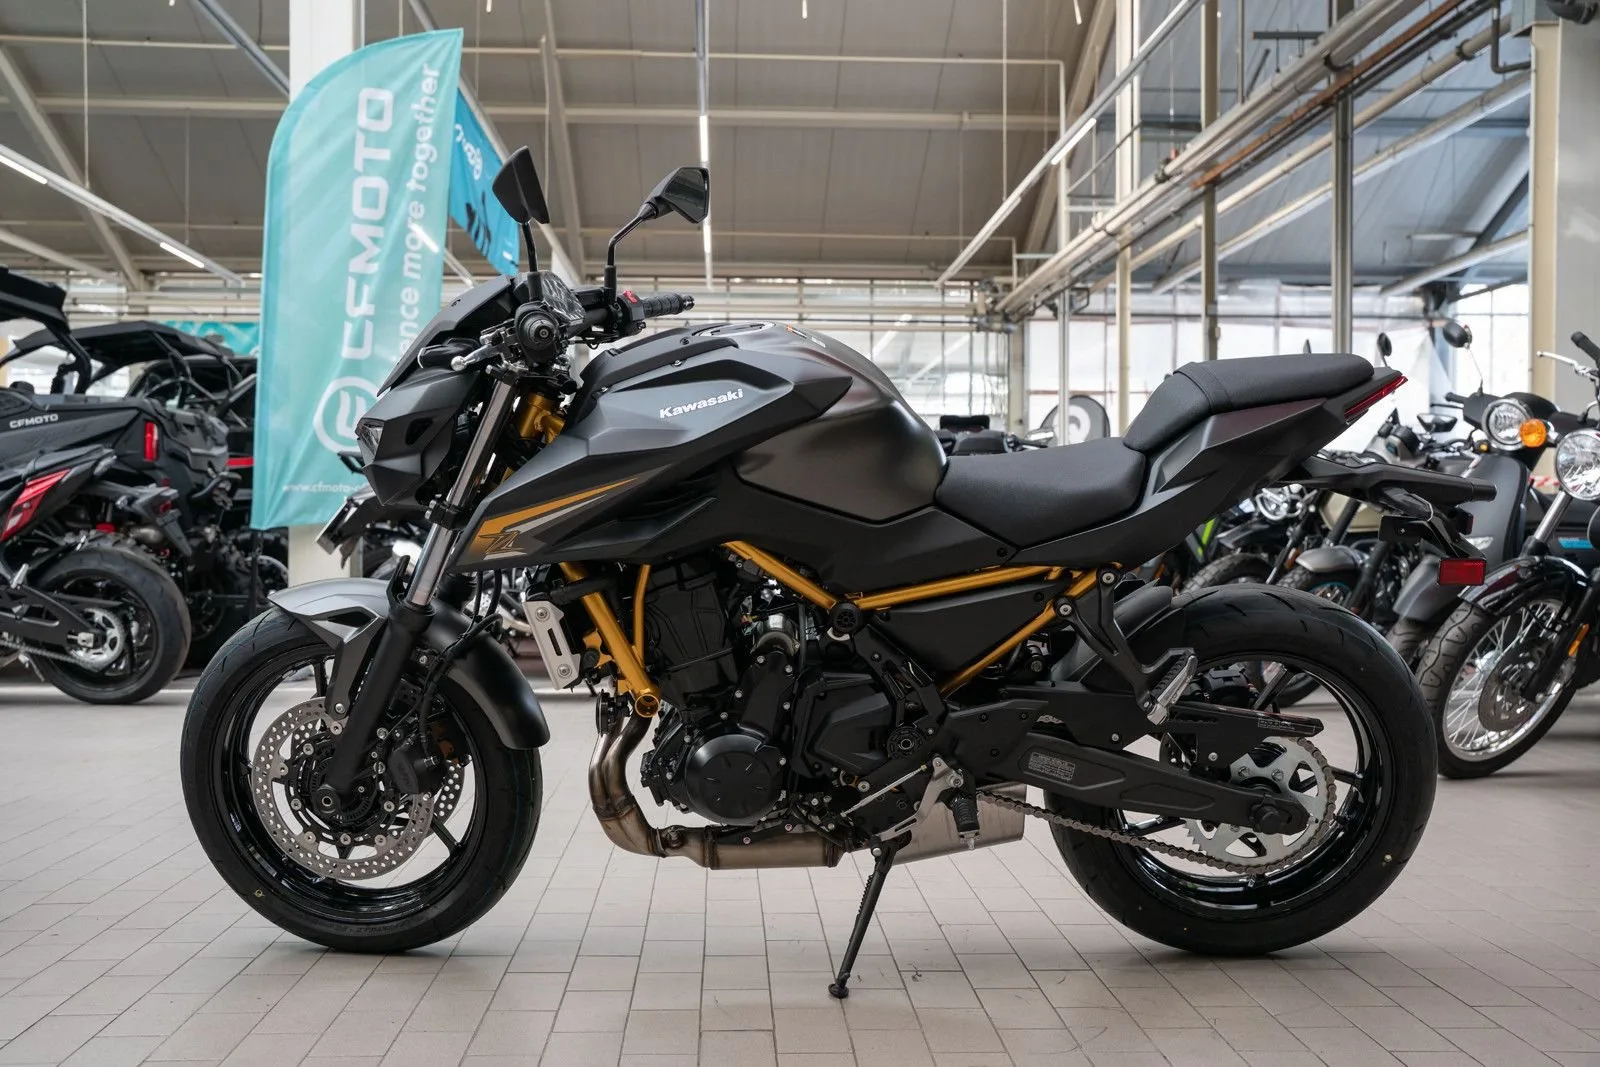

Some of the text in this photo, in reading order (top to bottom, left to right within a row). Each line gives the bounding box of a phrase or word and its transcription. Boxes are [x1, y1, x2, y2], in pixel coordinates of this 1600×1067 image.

[407, 61, 441, 193] together
[341, 87, 394, 360] CFMOTO
[401, 199, 426, 280] more
[9, 413, 59, 428] CFMOTO
[659, 388, 744, 419] Kawasaki
